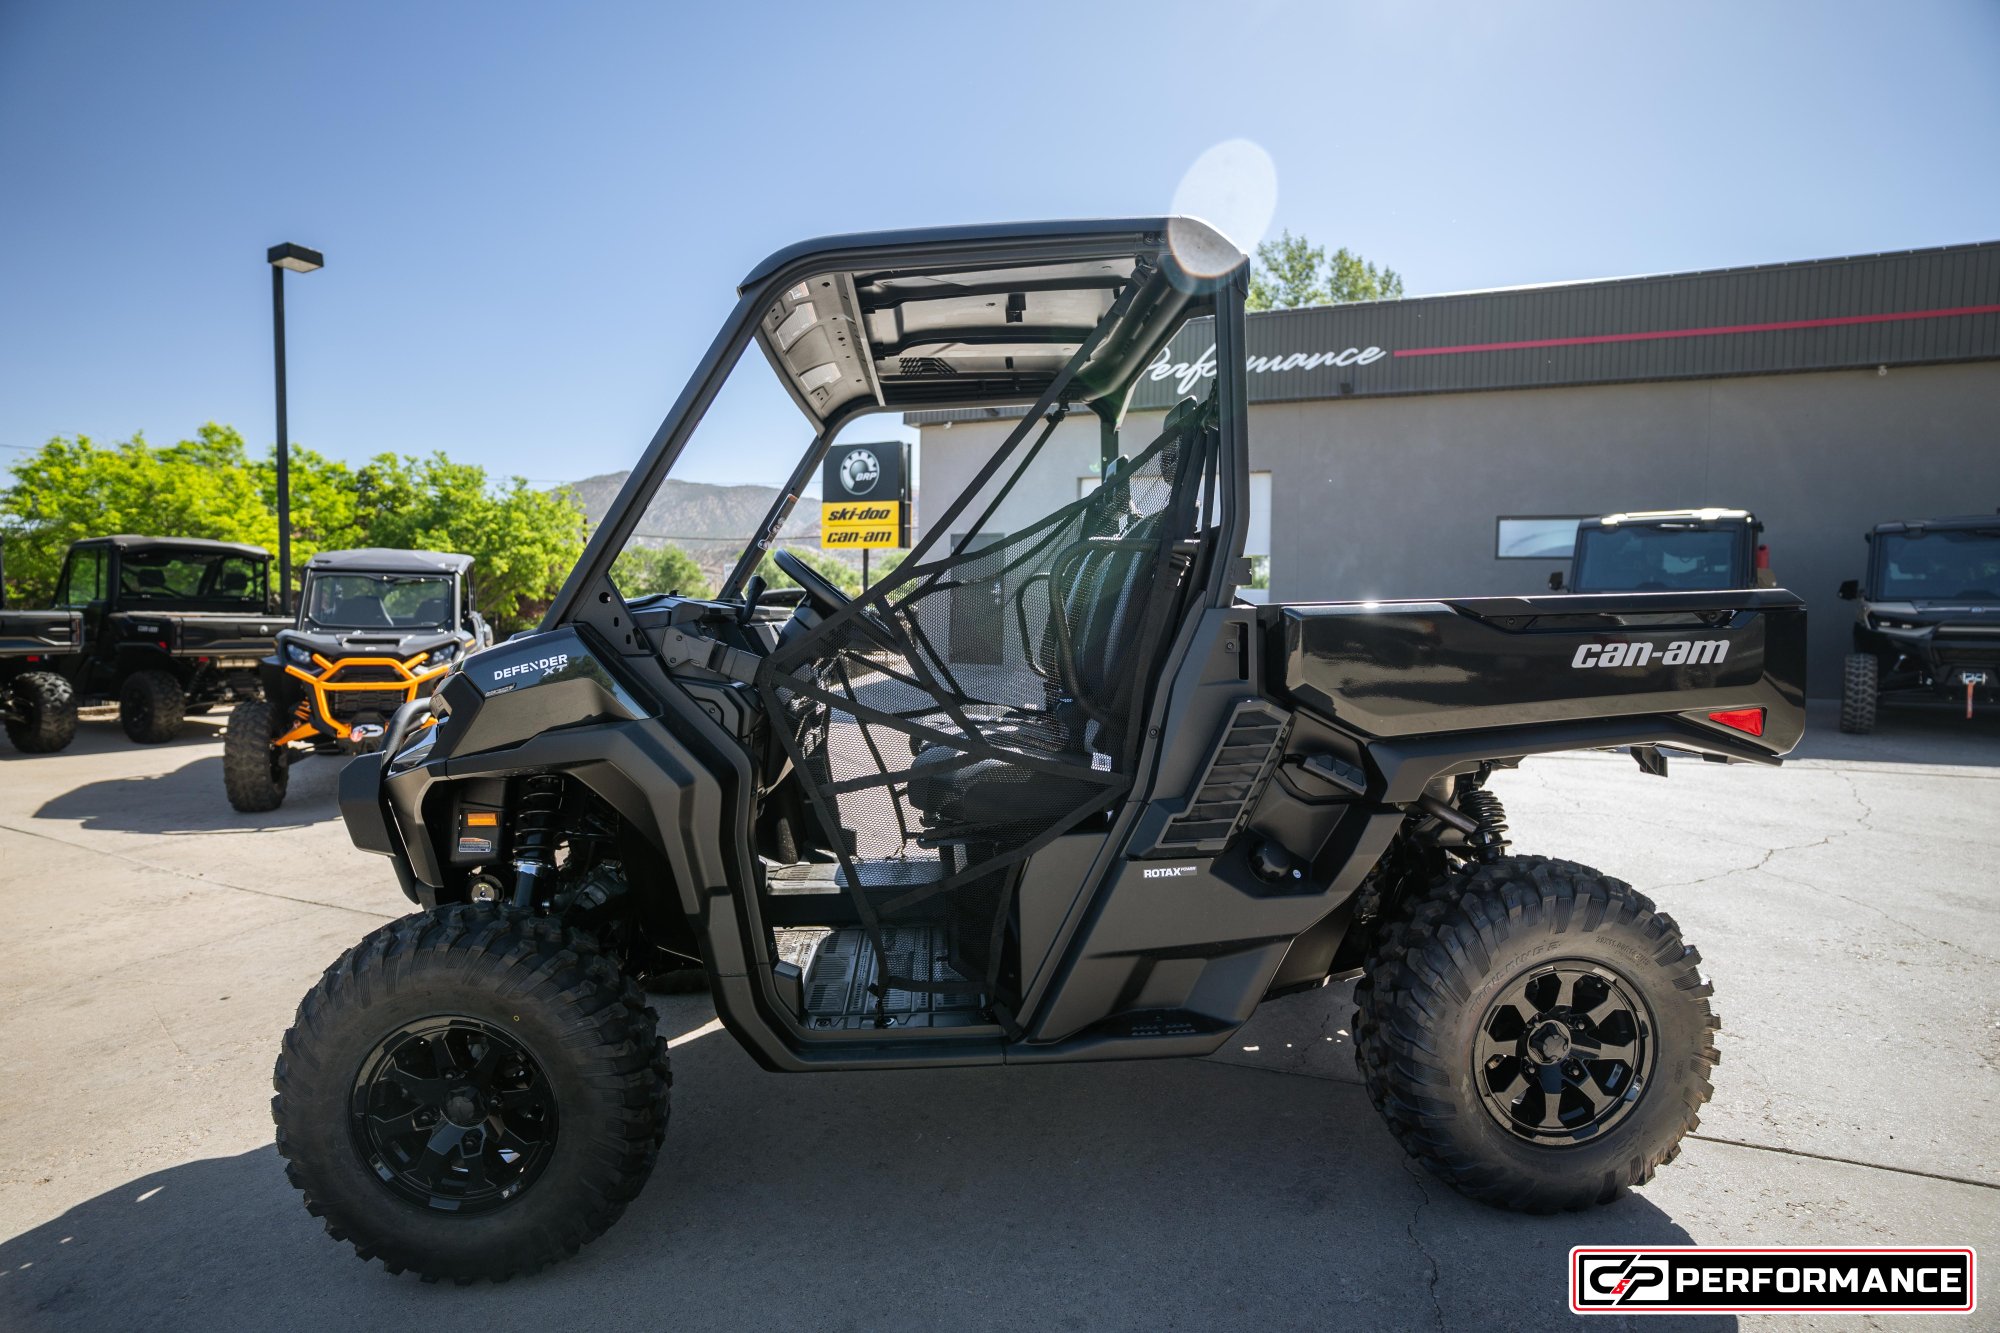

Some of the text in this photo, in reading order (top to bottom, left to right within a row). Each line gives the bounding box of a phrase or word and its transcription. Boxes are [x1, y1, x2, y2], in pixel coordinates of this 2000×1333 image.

[1147, 343, 1387, 395] erfomance
[855, 472, 878, 482] BRP
[828, 507, 891, 521] ski-doo
[827, 531, 892, 543] can-am
[1571, 640, 1730, 669] can-am
[493, 654, 568, 681] DEFENDER
[542, 663, 568, 677] XT
[1143, 867, 1182, 878] ROTAX
